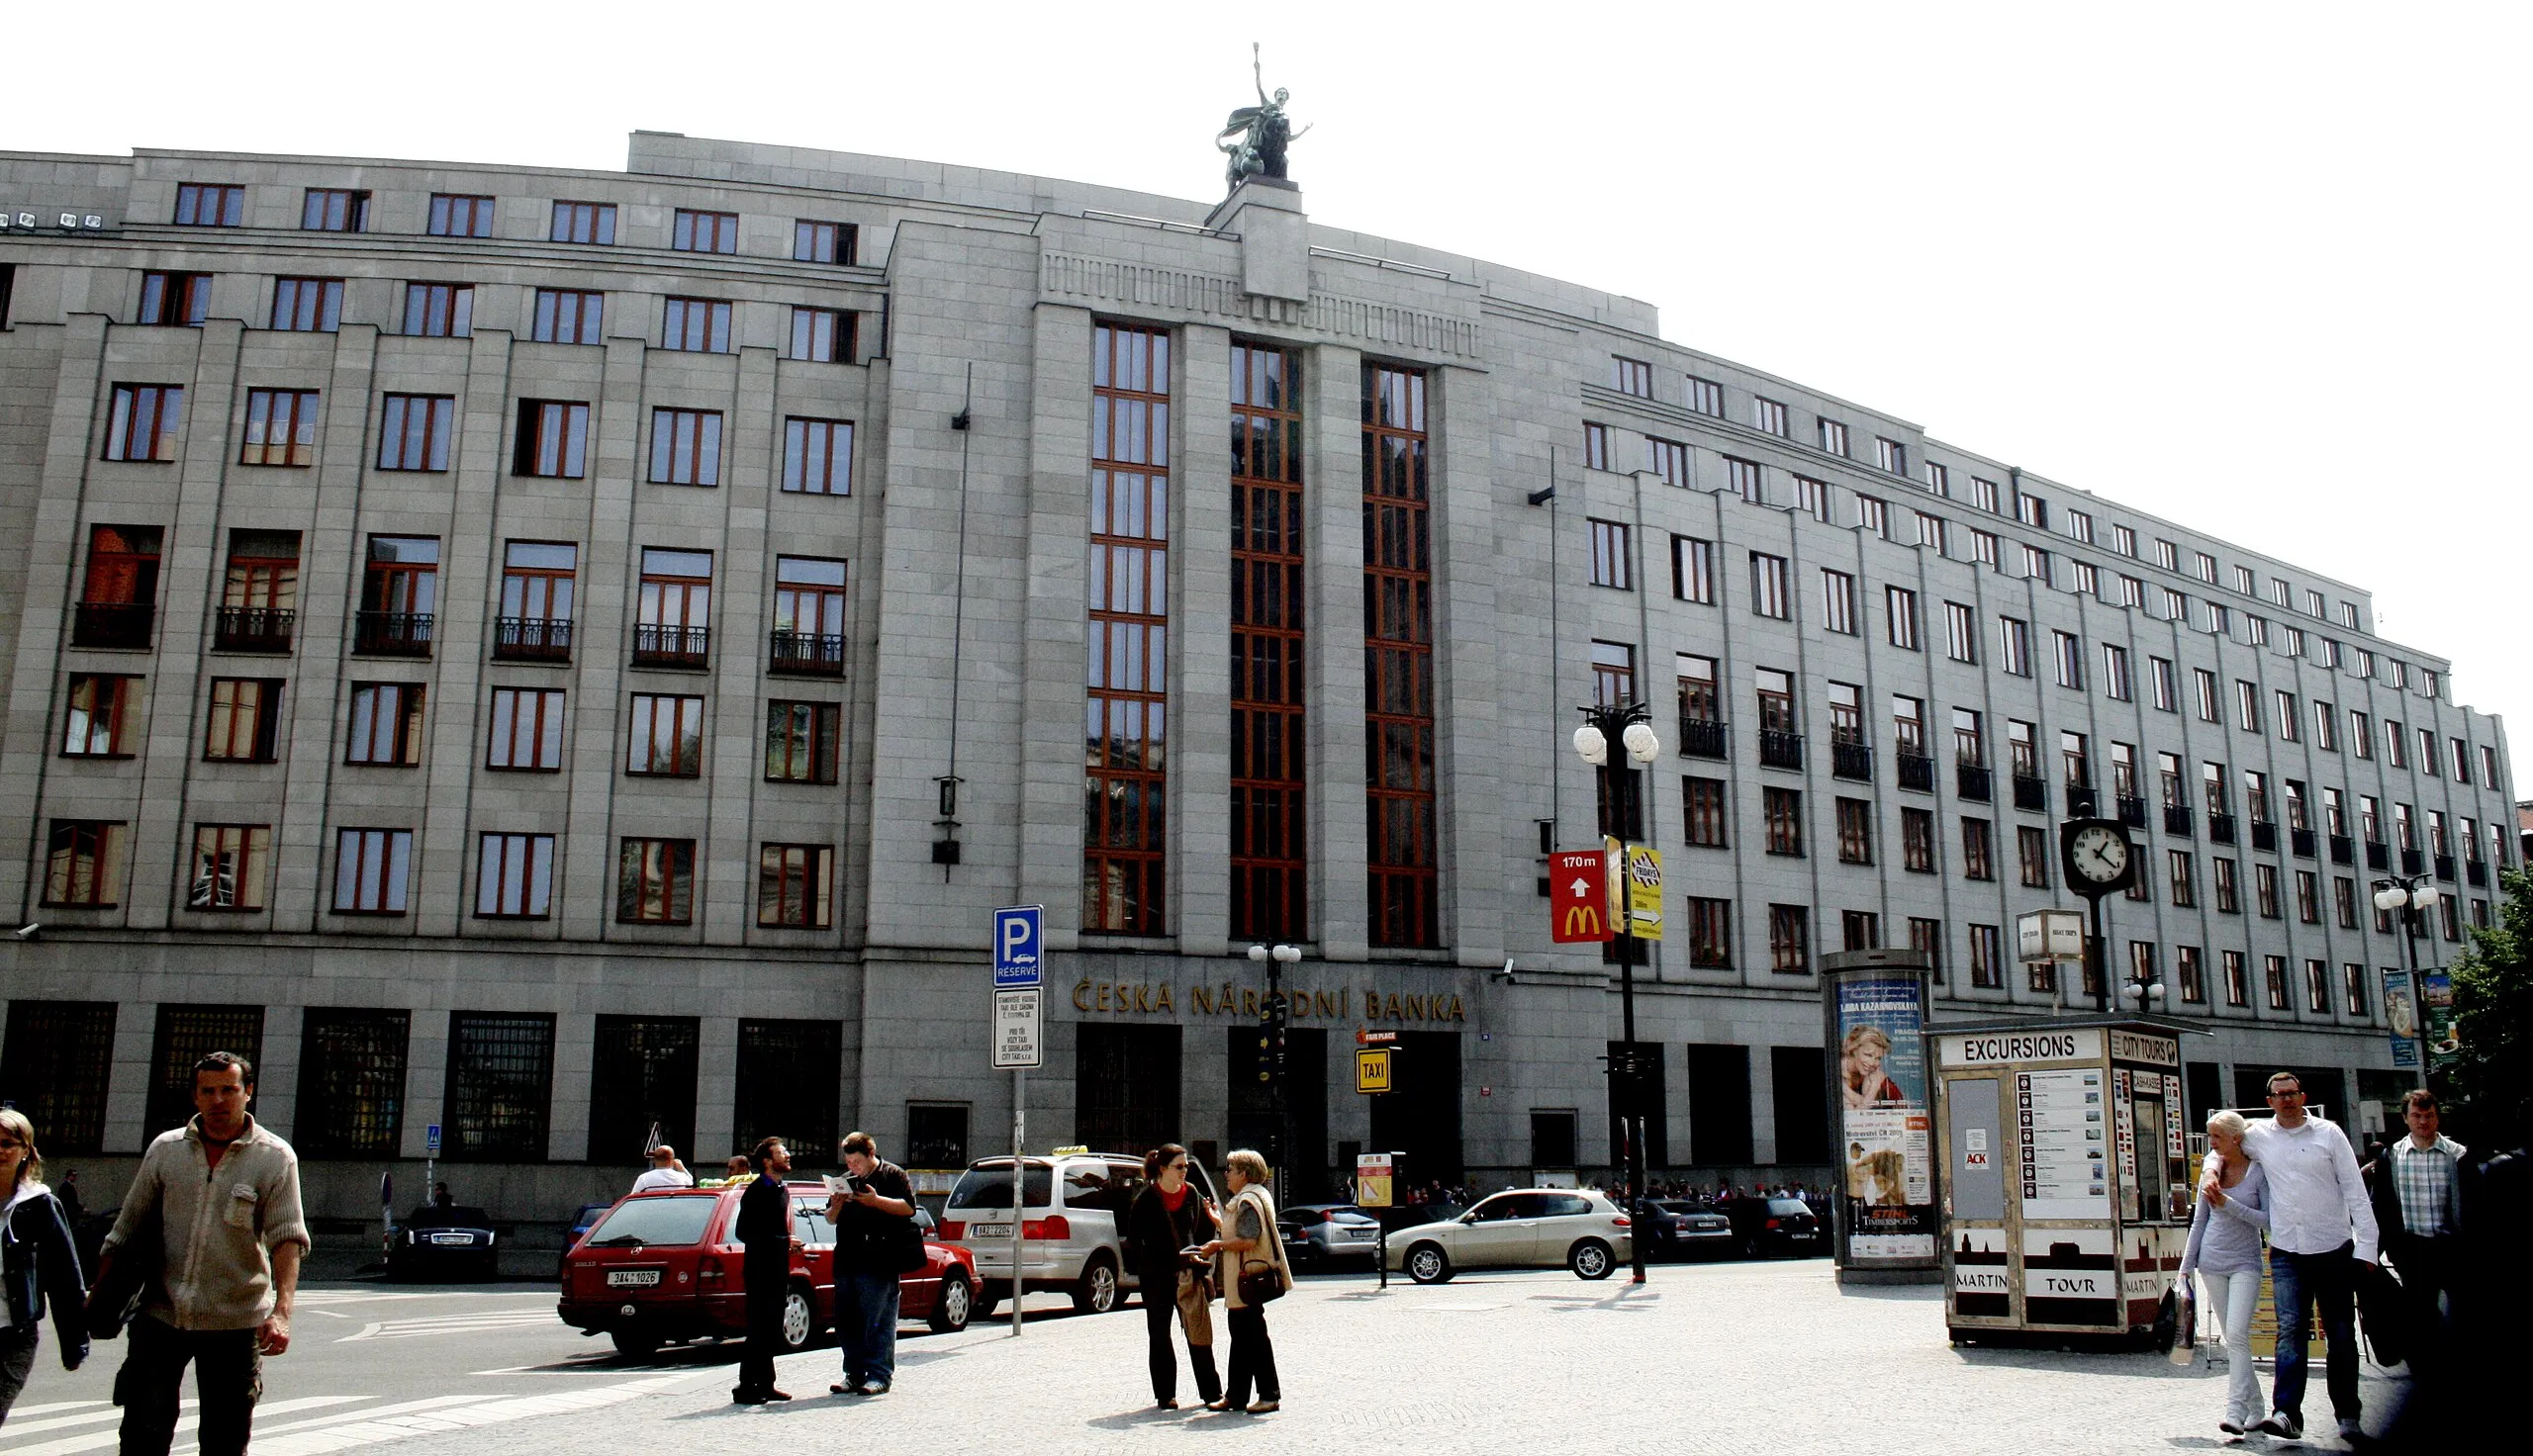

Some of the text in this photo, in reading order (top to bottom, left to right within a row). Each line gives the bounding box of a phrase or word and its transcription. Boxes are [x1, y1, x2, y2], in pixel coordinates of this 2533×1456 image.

[1562, 857, 1596, 867] 170 m
[1004, 918, 1031, 962] P
[997, 964, 1037, 977] RÉSERVÉ
[1073, 976, 1173, 1013] ČESKÁ
[1366, 991, 1465, 1022] BANKA
[1964, 1035, 2075, 1060] EXCURSIONS
[2123, 1036, 2138, 1057] CITY
[2140, 1038, 2166, 1060] TOURS
[1362, 1062, 1384, 1079] TAXI
[1966, 1153, 1986, 1164] ACK
[636, 1272, 656, 1282] 1026
[1956, 1274, 2008, 1288] MARTIN
[2045, 1277, 2096, 1293] TOUR
[2123, 1279, 2157, 1293] MARTIN
